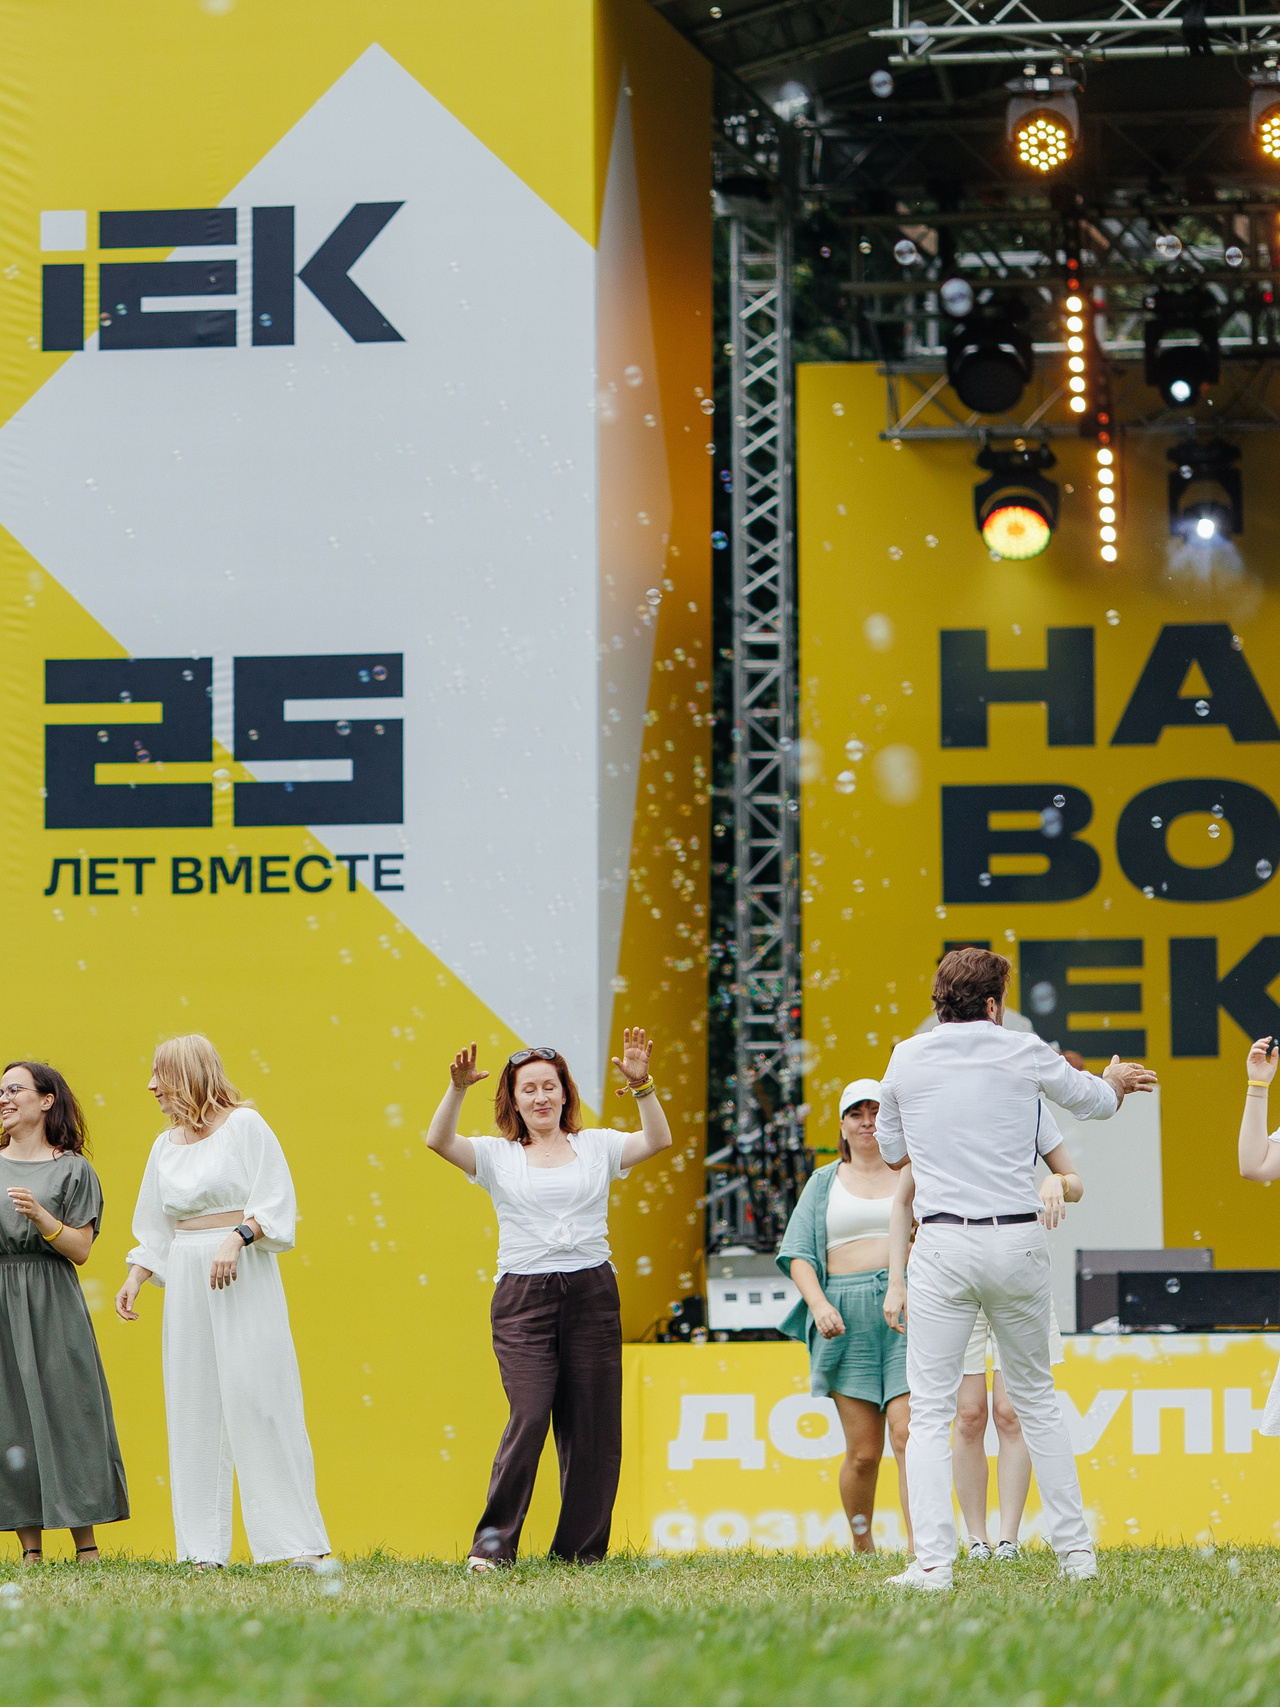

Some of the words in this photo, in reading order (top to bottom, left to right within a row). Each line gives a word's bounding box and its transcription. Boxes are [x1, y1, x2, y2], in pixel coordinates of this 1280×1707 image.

[44, 653, 404, 829] 25
[939, 622, 1280, 748] НА
[44, 857, 156, 896] ЛЕТ
[171, 854, 405, 895] ВМЕСТЕ
[941, 777, 1280, 905] ВО
[942, 934, 1280, 1059] EK
